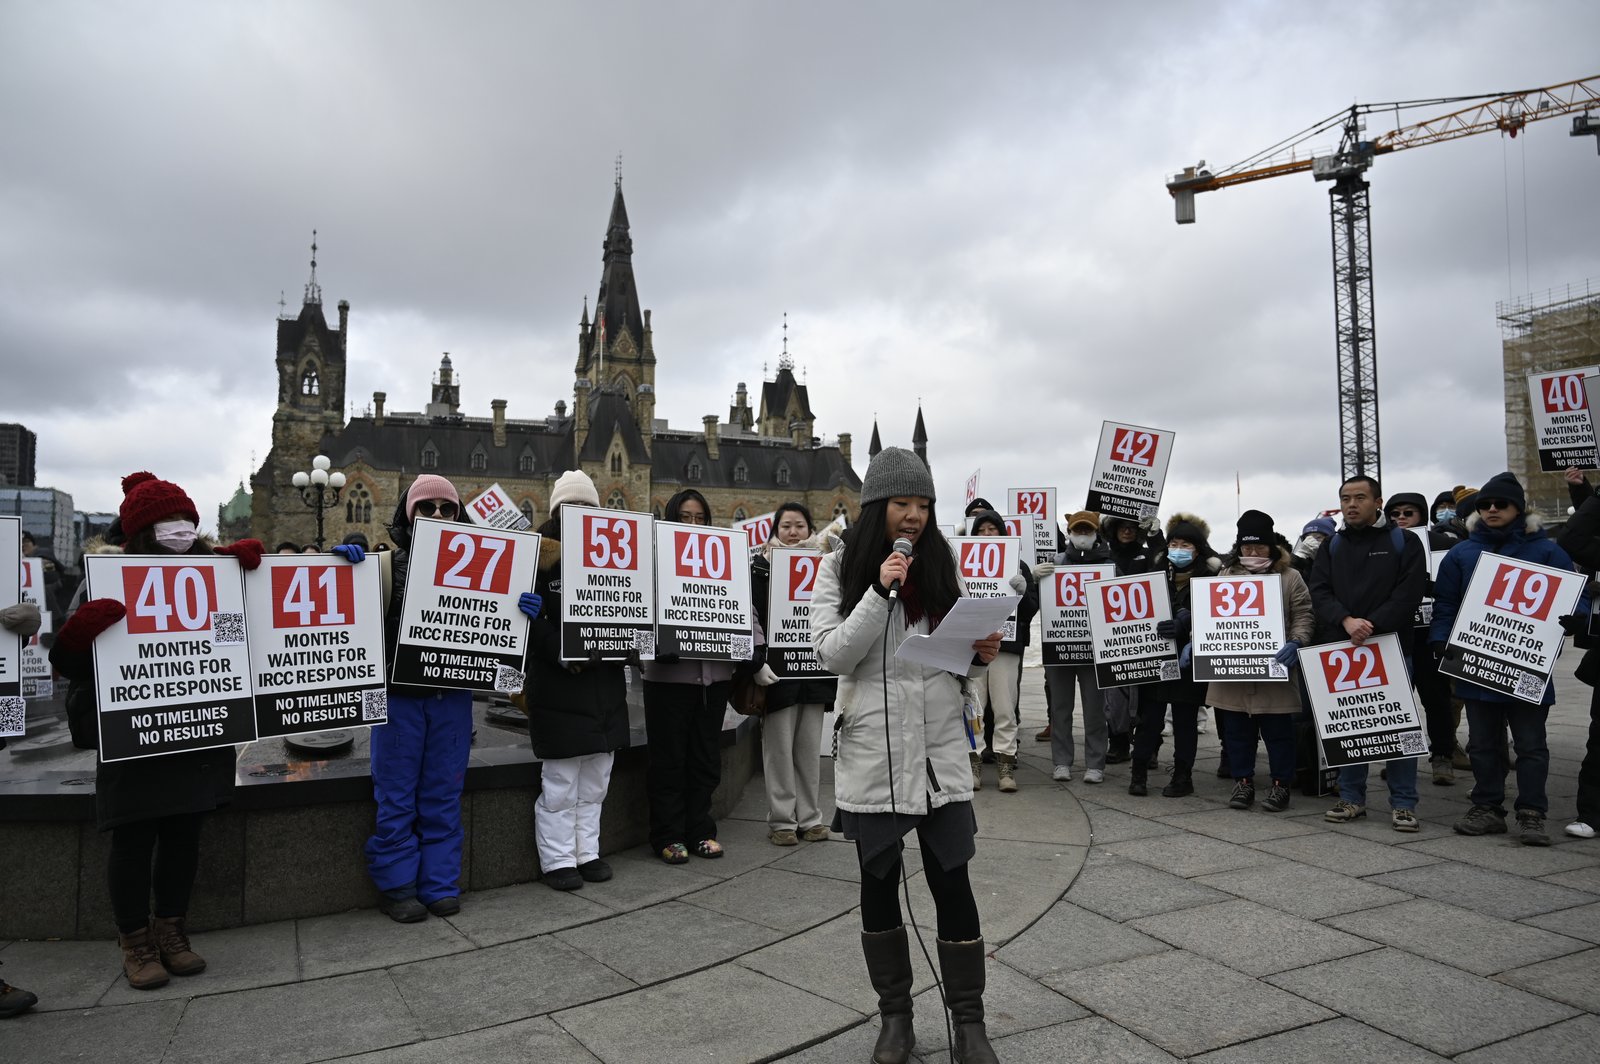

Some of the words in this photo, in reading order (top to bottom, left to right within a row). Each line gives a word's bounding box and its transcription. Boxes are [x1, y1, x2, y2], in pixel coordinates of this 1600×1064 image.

[1548, 375, 1583, 411] 40
[1551, 414, 1586, 424] MONTHS
[1544, 425, 1578, 435] WAITING
[1116, 431, 1153, 465] 42
[1541, 437, 1559, 446] IRCC
[1112, 465, 1147, 477] MONTHS
[1102, 472, 1135, 484] WAITING
[1138, 479, 1153, 488] FOR
[1095, 481, 1113, 490] IRCC
[1114, 484, 1156, 498] RESPONSE
[477, 494, 500, 517] 19
[1021, 492, 1044, 519] 32
[1101, 503, 1111, 511] NO
[1112, 505, 1140, 516] RESULTS
[1111, 497, 1141, 508] TIMELINE
[488, 508, 505, 522] MONTHS
[746, 520, 770, 545] 70
[590, 517, 632, 569] 53
[442, 533, 507, 591] 27
[681, 533, 725, 579] 40
[964, 543, 1001, 577] 40
[588, 574, 631, 588] MONTHS
[682, 583, 727, 596] MONTHS
[1060, 573, 1095, 606] 65
[136, 567, 208, 631] 40
[283, 567, 345, 625] 41
[576, 589, 620, 602] WAITING
[623, 591, 642, 603] FOR
[1216, 582, 1258, 616] 32
[1493, 568, 1549, 616] 19
[438, 594, 498, 613] MONTHS
[671, 596, 715, 608] WAITING
[719, 600, 739, 610] FOR
[1107, 582, 1148, 622] 90
[570, 604, 593, 616] IRCC
[595, 605, 648, 618] RESPONSE
[665, 609, 688, 621] IRCC
[690, 612, 745, 624] RESPONSE
[421, 609, 480, 629] WAITING
[484, 617, 512, 631] FOR
[782, 619, 811, 629] WAITI
[1052, 620, 1087, 628] WAITING
[1216, 621, 1259, 630] MONTHS
[1485, 612, 1535, 634] MONTHS
[409, 625, 441, 641] IRCC
[443, 629, 518, 649] RESPONSE
[580, 627, 592, 637] NO
[676, 630, 688, 639] NO
[690, 631, 734, 641] TIMELINE
[775, 632, 797, 642] IRCC
[1067, 630, 1091, 638] RESP
[1112, 623, 1151, 635] MONTHS
[1206, 632, 1248, 641] WAITING
[1251, 631, 1271, 639] FOR
[1469, 621, 1517, 643] WAITING
[1519, 636, 1543, 652] FOR
[284, 630, 350, 648] MONTHS
[584, 640, 596, 650] NO
[599, 641, 634, 650] RESULTS
[680, 642, 692, 651] NO
[695, 642, 731, 653] RESULTS
[1104, 636, 1143, 647] WAITING
[1200, 643, 1222, 651] IRCC
[1224, 642, 1278, 651] RESPONSE
[138, 640, 212, 659] MONTHS
[267, 649, 334, 668] WAITING
[338, 647, 367, 662] FOR
[784, 651, 796, 660] NO
[1100, 650, 1120, 659] IRCC
[1122, 642, 1170, 655] RESPONSE
[1457, 631, 1483, 646] IRCC
[1483, 640, 1546, 667] RESPONSE
[420, 651, 437, 664] NO
[440, 653, 500, 669] TIMELINES
[787, 662, 799, 671] NO
[1123, 660, 1162, 671] TIMELINES
[1223, 658, 1269, 666] TIMELINES
[1329, 646, 1381, 691] 22
[1462, 652, 1476, 663] NO
[1477, 656, 1524, 677] TIMELINE
[120, 660, 194, 681] WAITING
[200, 658, 231, 674] FOR
[258, 671, 294, 687] IRCC
[296, 664, 376, 684] RESPONSE
[423, 665, 441, 678] NO
[443, 668, 493, 682] RESULTS
[1128, 669, 1160, 678] RESULTS
[1462, 664, 1476, 675] NO
[1477, 668, 1517, 689] RESULTS
[110, 685, 151, 703] IRCC
[154, 676, 243, 699] RESPONSE
[276, 698, 294, 711] NO
[296, 691, 362, 708] TIMELINES
[1337, 691, 1386, 707] MONTHS
[131, 714, 152, 729] NO
[155, 706, 228, 726] TIMELINES
[282, 713, 300, 725] NO
[304, 706, 357, 723] RESULTS
[1328, 706, 1376, 720] WAITING
[1378, 702, 1402, 714] FOR
[1325, 723, 1350, 734] IRCC
[1351, 713, 1412, 730] RESPONSE
[139, 731, 160, 746] NO
[163, 723, 224, 742] RESULTS
[1340, 739, 1355, 749] NO
[1347, 749, 1360, 758] NO
[1363, 744, 1402, 756] RESULTS
